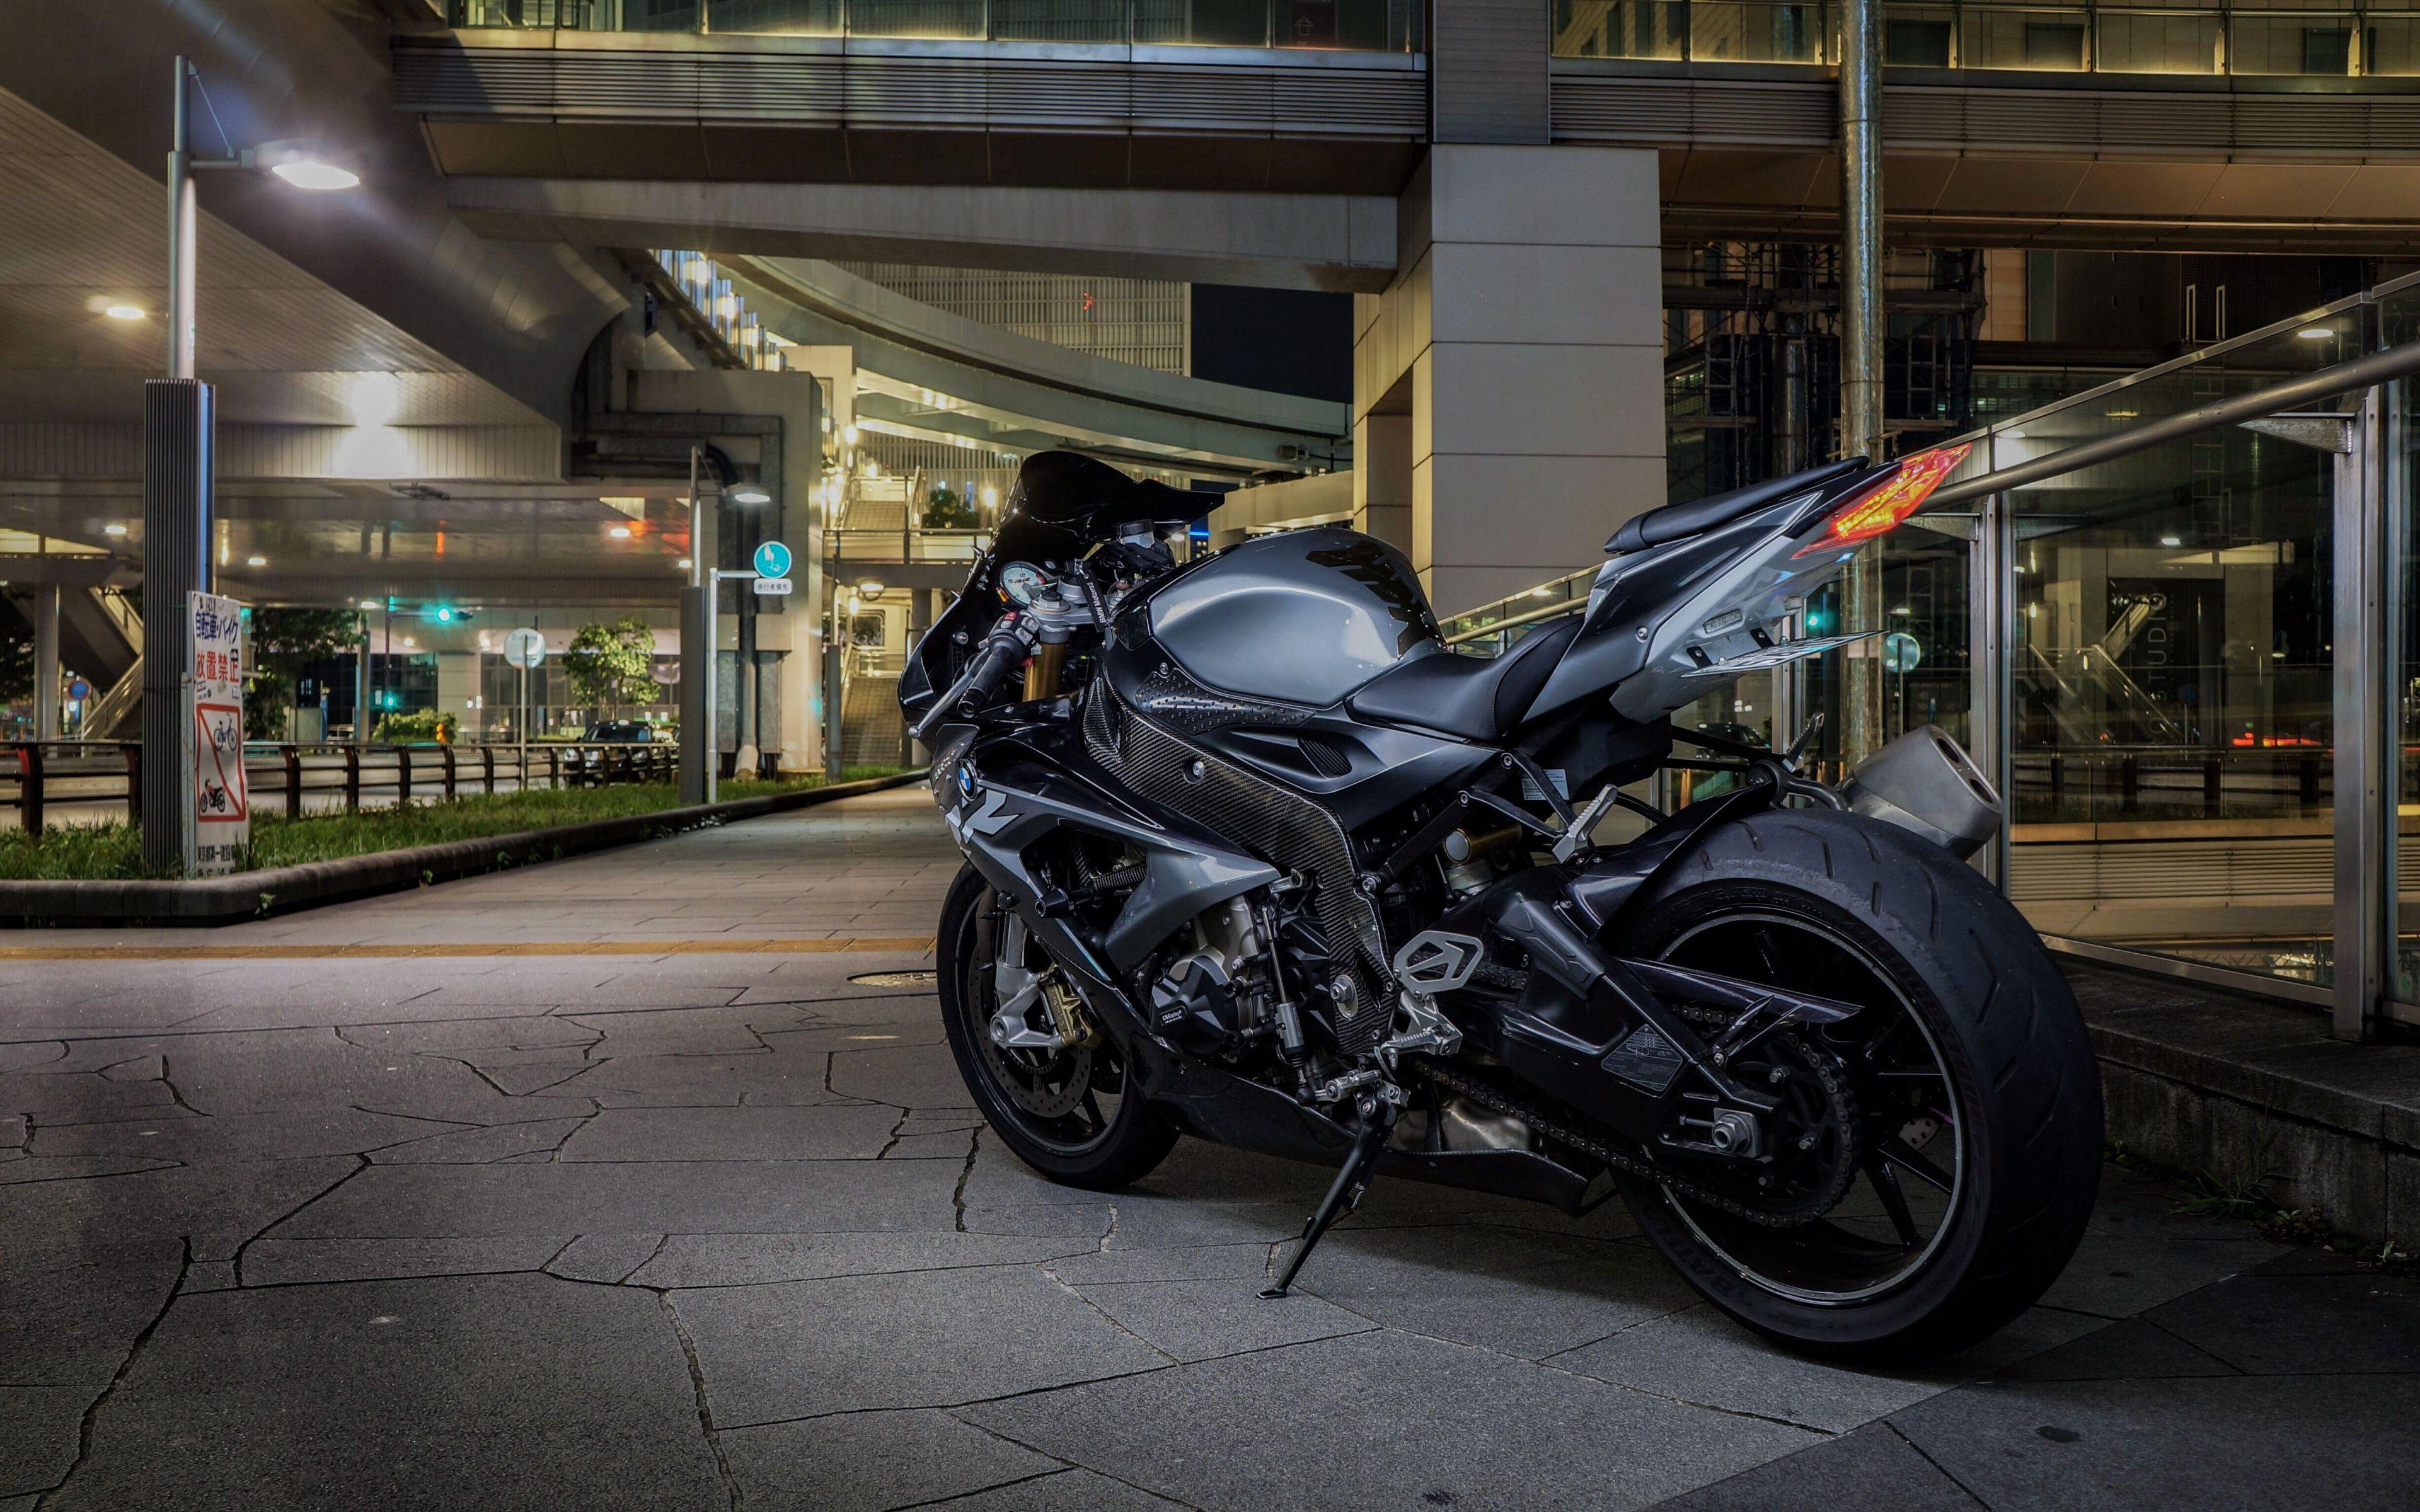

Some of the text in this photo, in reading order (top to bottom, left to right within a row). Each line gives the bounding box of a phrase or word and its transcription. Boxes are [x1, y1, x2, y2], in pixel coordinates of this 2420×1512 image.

[1086, 581, 1106, 624] BMW Motorrad
[2148, 593, 2167, 701] STUDIO
